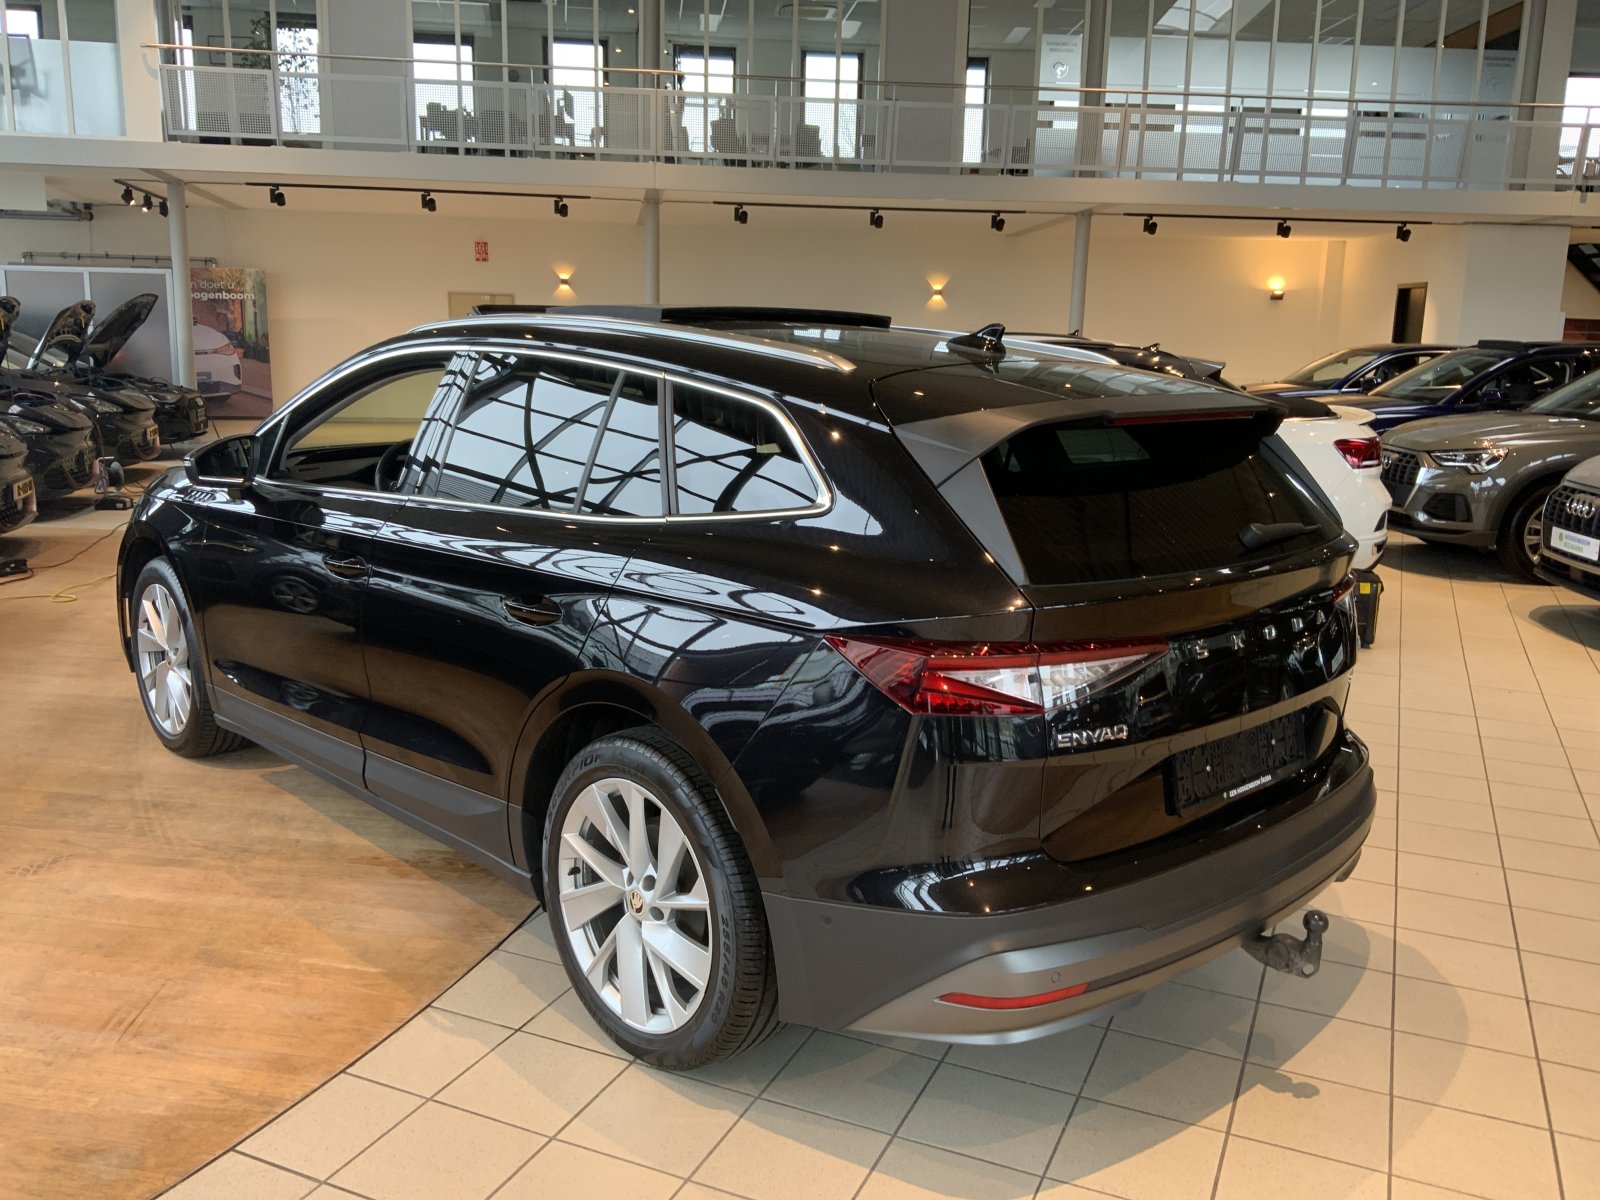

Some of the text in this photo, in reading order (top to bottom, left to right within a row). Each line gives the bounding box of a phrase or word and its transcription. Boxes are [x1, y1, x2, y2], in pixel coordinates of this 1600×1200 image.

[200, 280, 226, 289] doet
[191, 290, 256, 301] ogenboom
[1057, 724, 1129, 748] ENYAQ
